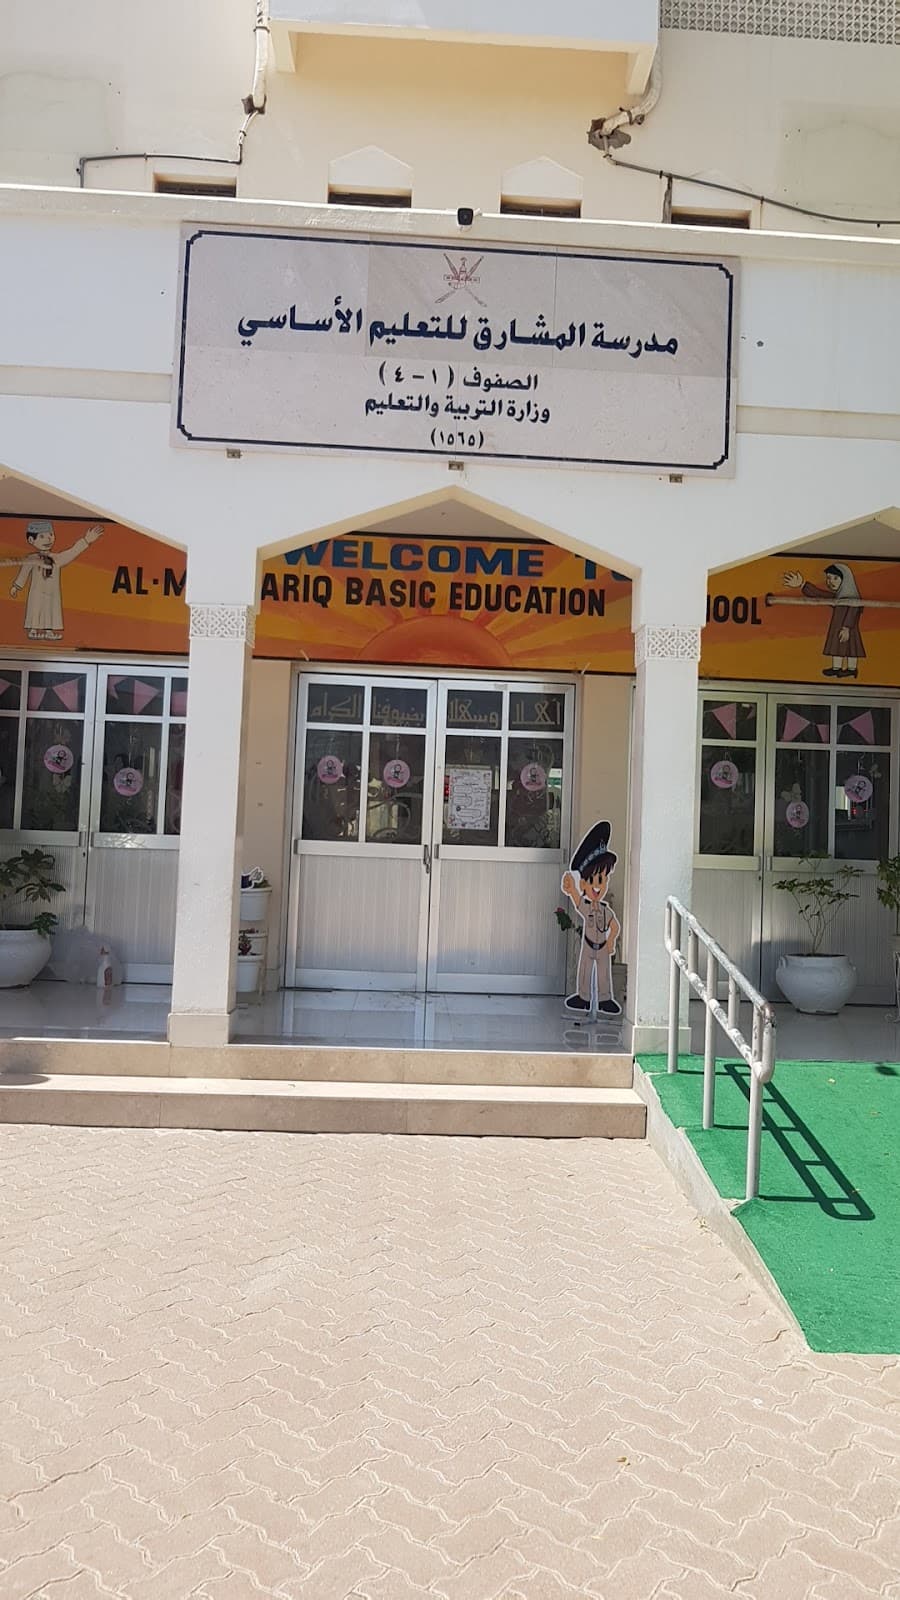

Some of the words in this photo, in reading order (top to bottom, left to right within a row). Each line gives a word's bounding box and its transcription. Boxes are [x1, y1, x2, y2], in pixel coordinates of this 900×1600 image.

[238, 295, 362, 346] الأساسي
[369, 311, 467, 347] للتعليم
[473, 314, 586, 350] المشارق
[591, 322, 679, 358] مدرسة
[463, 366, 539, 392] الصفوف
[365, 392, 439, 417] والتعليم
[444, 395, 503, 420] التربية
[507, 399, 551, 423] وزارة
[284, 539, 544, 577] WELCOME
[346, 577, 436, 609] BASIC
[450, 582, 605, 617] EDUCATION
[706, 594, 762, 625] OOL
